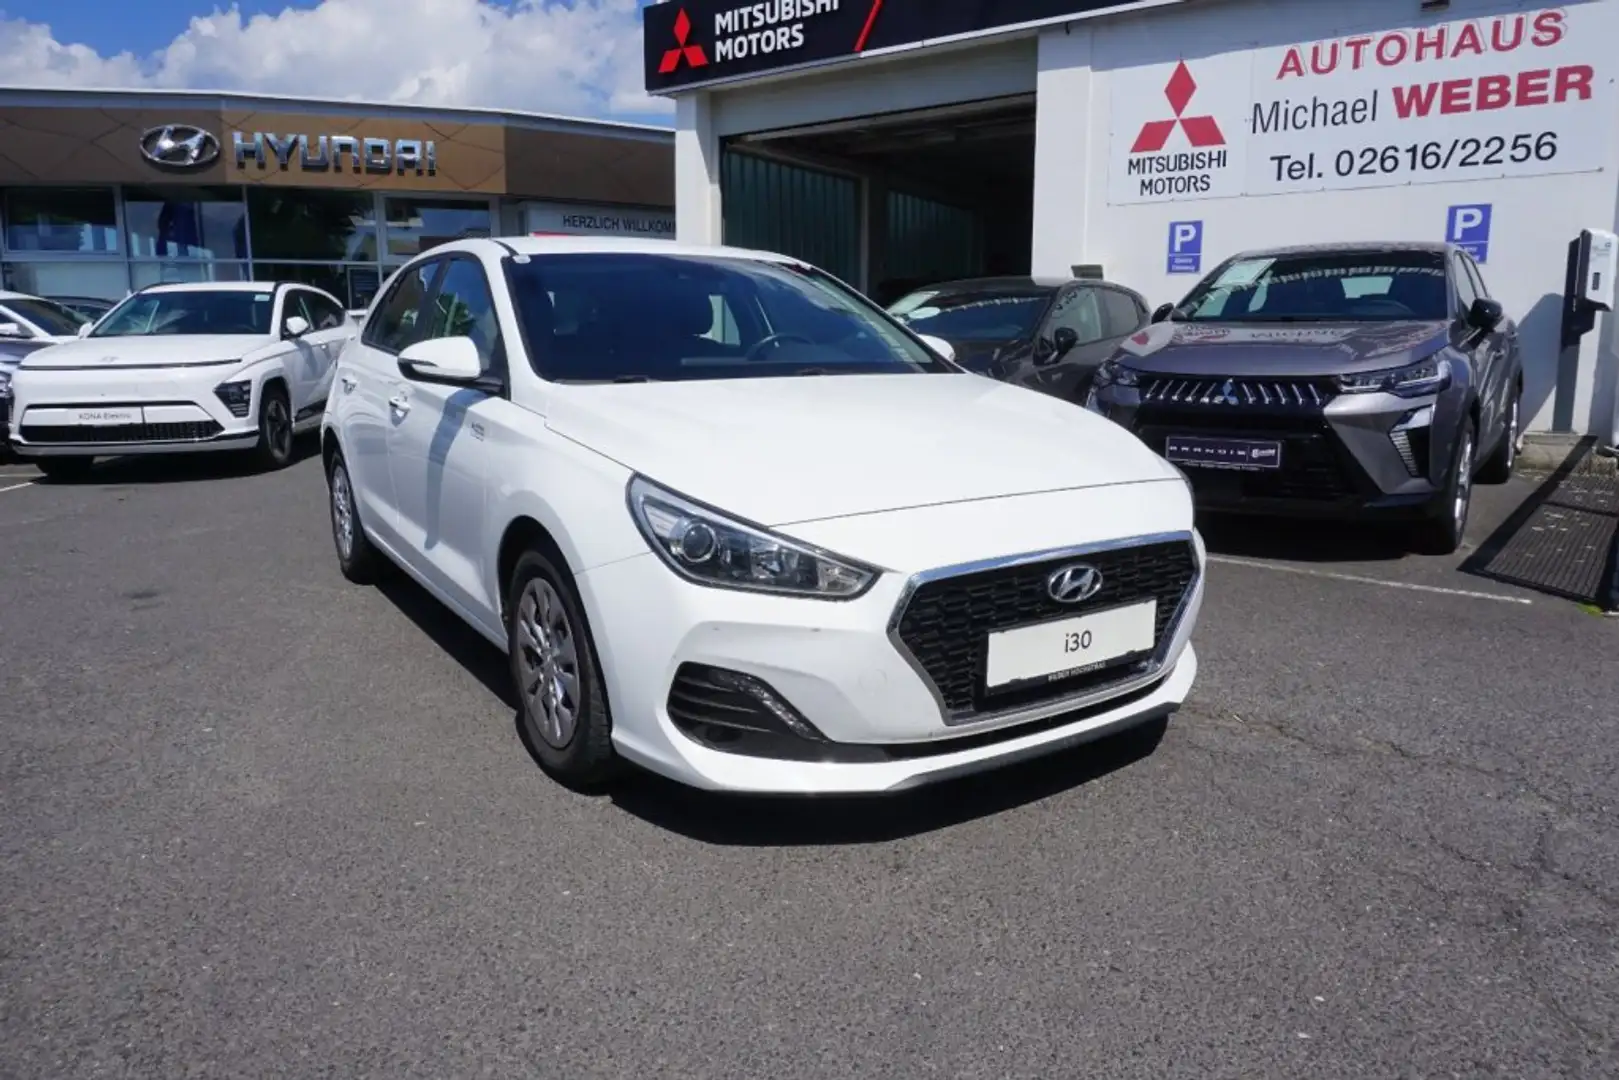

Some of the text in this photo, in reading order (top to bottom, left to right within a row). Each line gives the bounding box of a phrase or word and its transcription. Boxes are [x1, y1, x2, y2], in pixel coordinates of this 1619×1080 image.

[715, 23, 804, 62] MOTORS
[1276, 10, 1565, 80] AUTOHAUS
[1251, 64, 1594, 134] Michael WEBER
[232, 131, 436, 175] HYUNDAI
[1128, 149, 1227, 175] MITSUBISHI
[1270, 132, 1558, 181] Tel. 02616/2256
[1140, 174, 1211, 196] MOTORS
[563, 215, 620, 231] HERZLICH
[1174, 225, 1197, 252] P
[1454, 208, 1483, 240] P
[1064, 630, 1092, 653] i30
